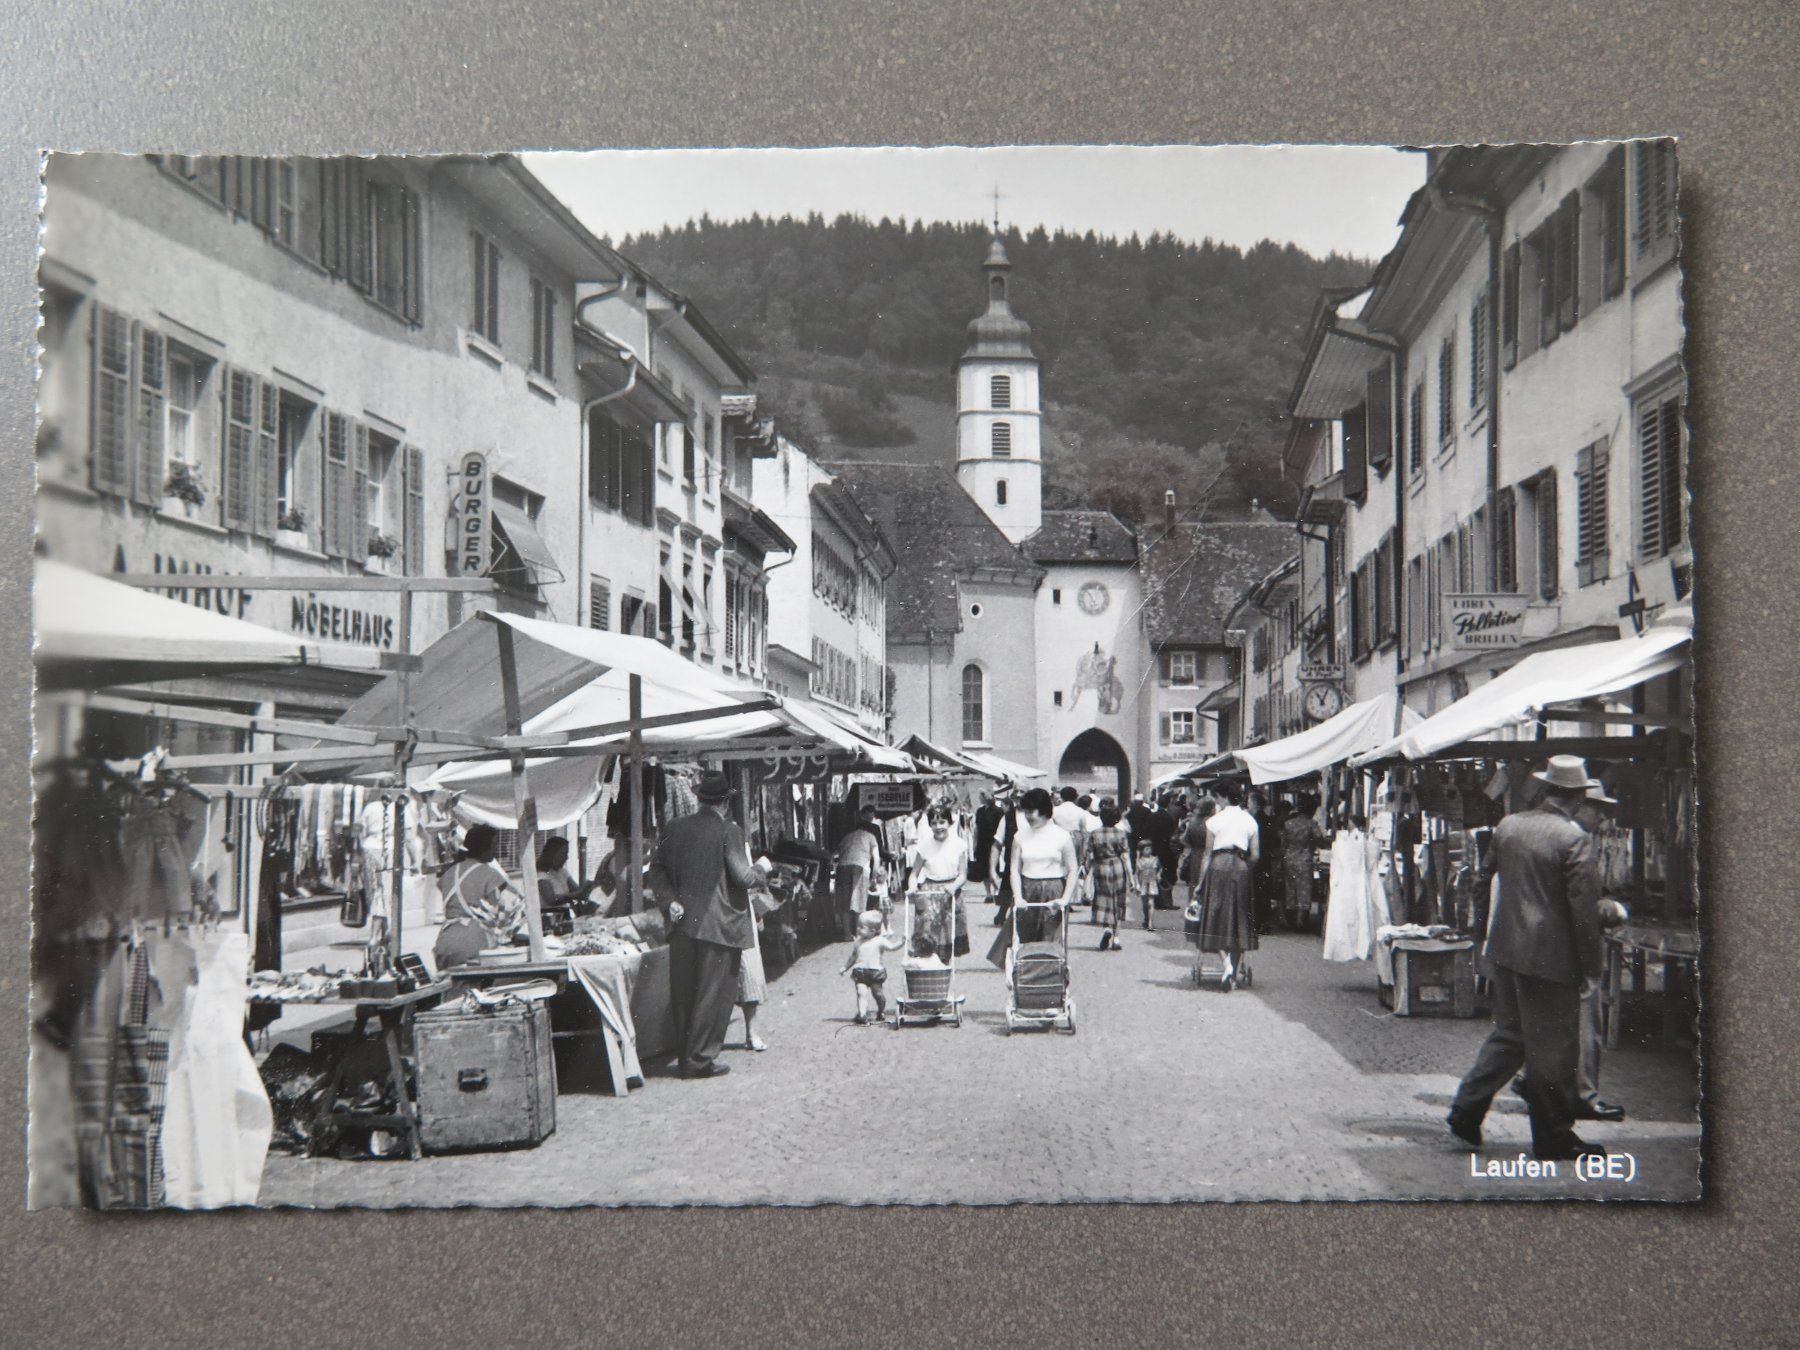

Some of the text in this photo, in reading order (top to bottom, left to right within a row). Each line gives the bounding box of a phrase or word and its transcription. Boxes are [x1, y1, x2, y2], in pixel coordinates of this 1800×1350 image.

[465, 461, 482, 571] BURGER
[291, 591, 393, 650] MÖBELHAUS
[1452, 610, 1522, 636] Pelletier
[1465, 634, 1517, 644] BRILLEN
[1301, 665, 1341, 673] UHREN
